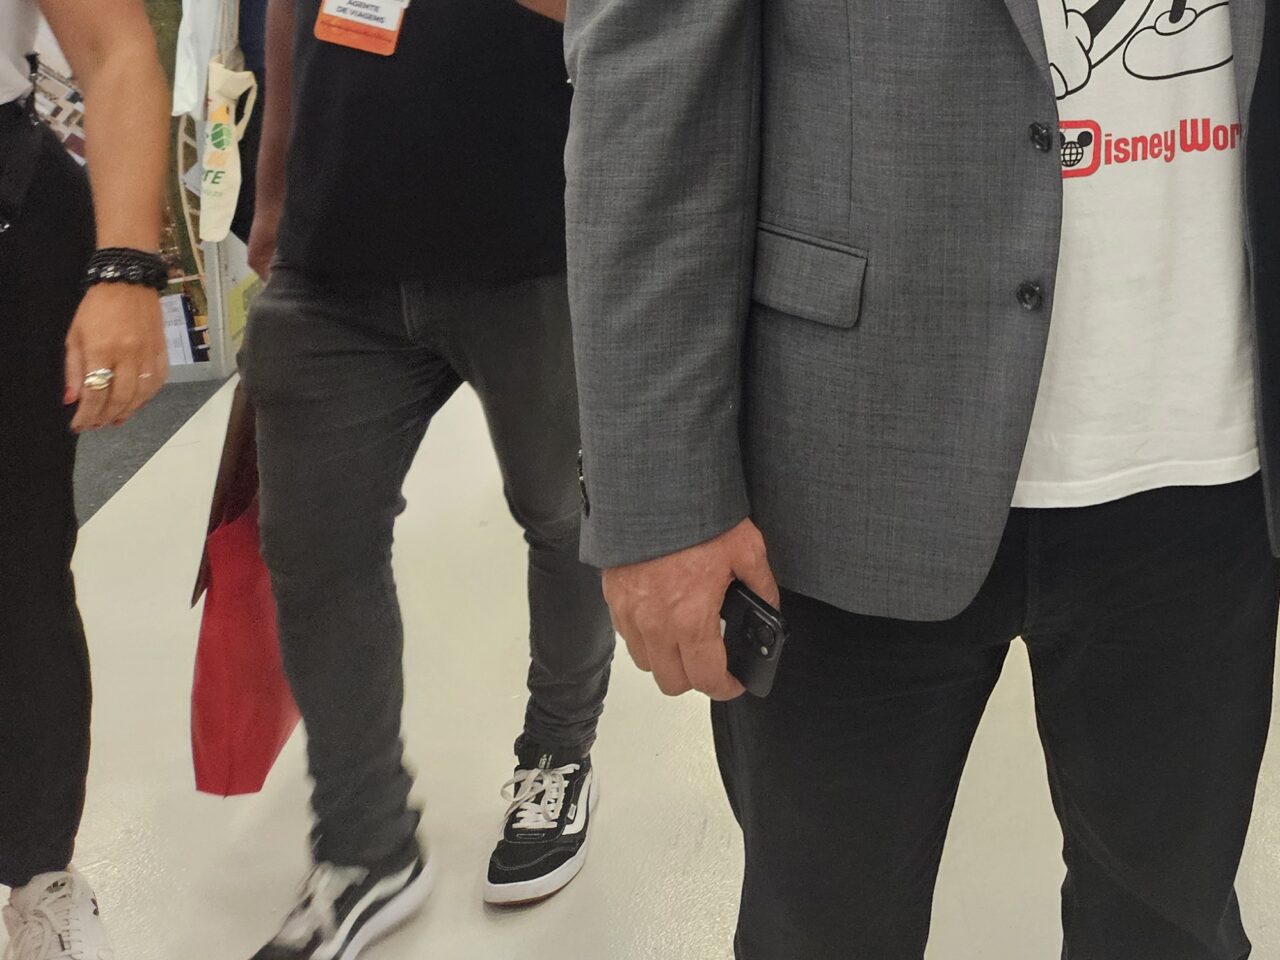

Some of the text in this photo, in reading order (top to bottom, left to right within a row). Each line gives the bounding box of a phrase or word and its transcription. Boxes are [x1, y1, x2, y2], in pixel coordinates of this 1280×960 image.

[336, 6, 385, 24] DE VIAGENS
[346, 0, 380, 13] AGENTE
[1179, 118, 1241, 154] Wor
